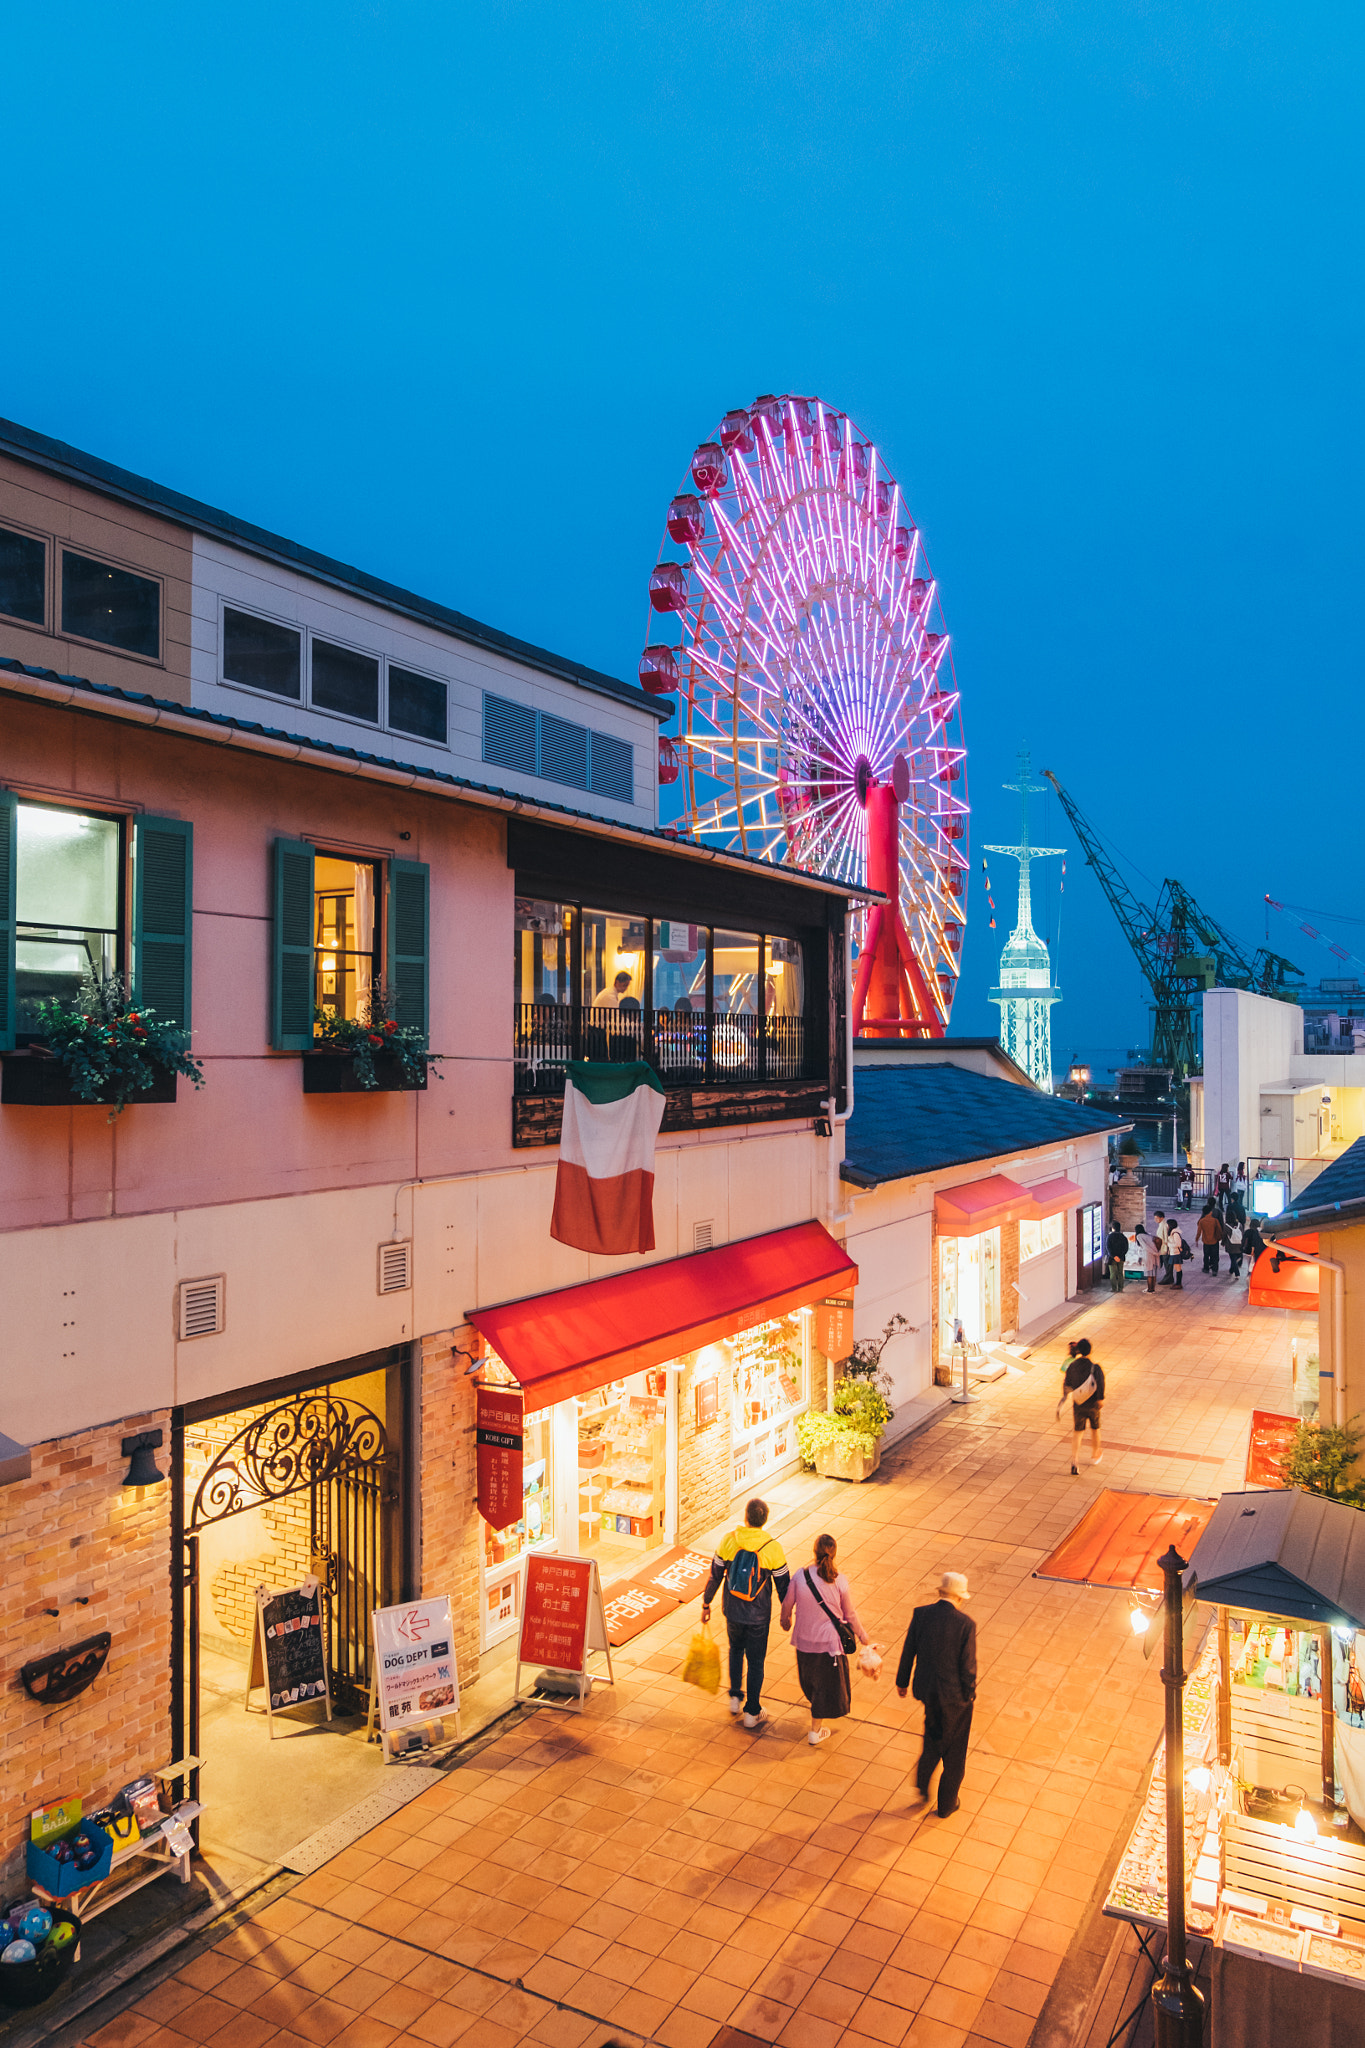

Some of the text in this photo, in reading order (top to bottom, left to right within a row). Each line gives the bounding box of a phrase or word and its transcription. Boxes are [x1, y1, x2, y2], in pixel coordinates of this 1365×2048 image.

[480, 1407, 520, 1423] 神戸百貨店
[485, 1433, 514, 1446] KOBE GIFT
[605, 1516, 642, 1537] 3 2 1
[542, 1565, 576, 1579] 神戸百貨店
[649, 1552, 713, 1592] 神戸百貨店
[535, 1582, 580, 1597] 神戸・兵庫
[542, 1599, 571, 1612] お土産
[384, 1656, 405, 1669] DOG
[406, 1649, 428, 1664] DEPT
[42, 1816, 71, 1834] BALL
